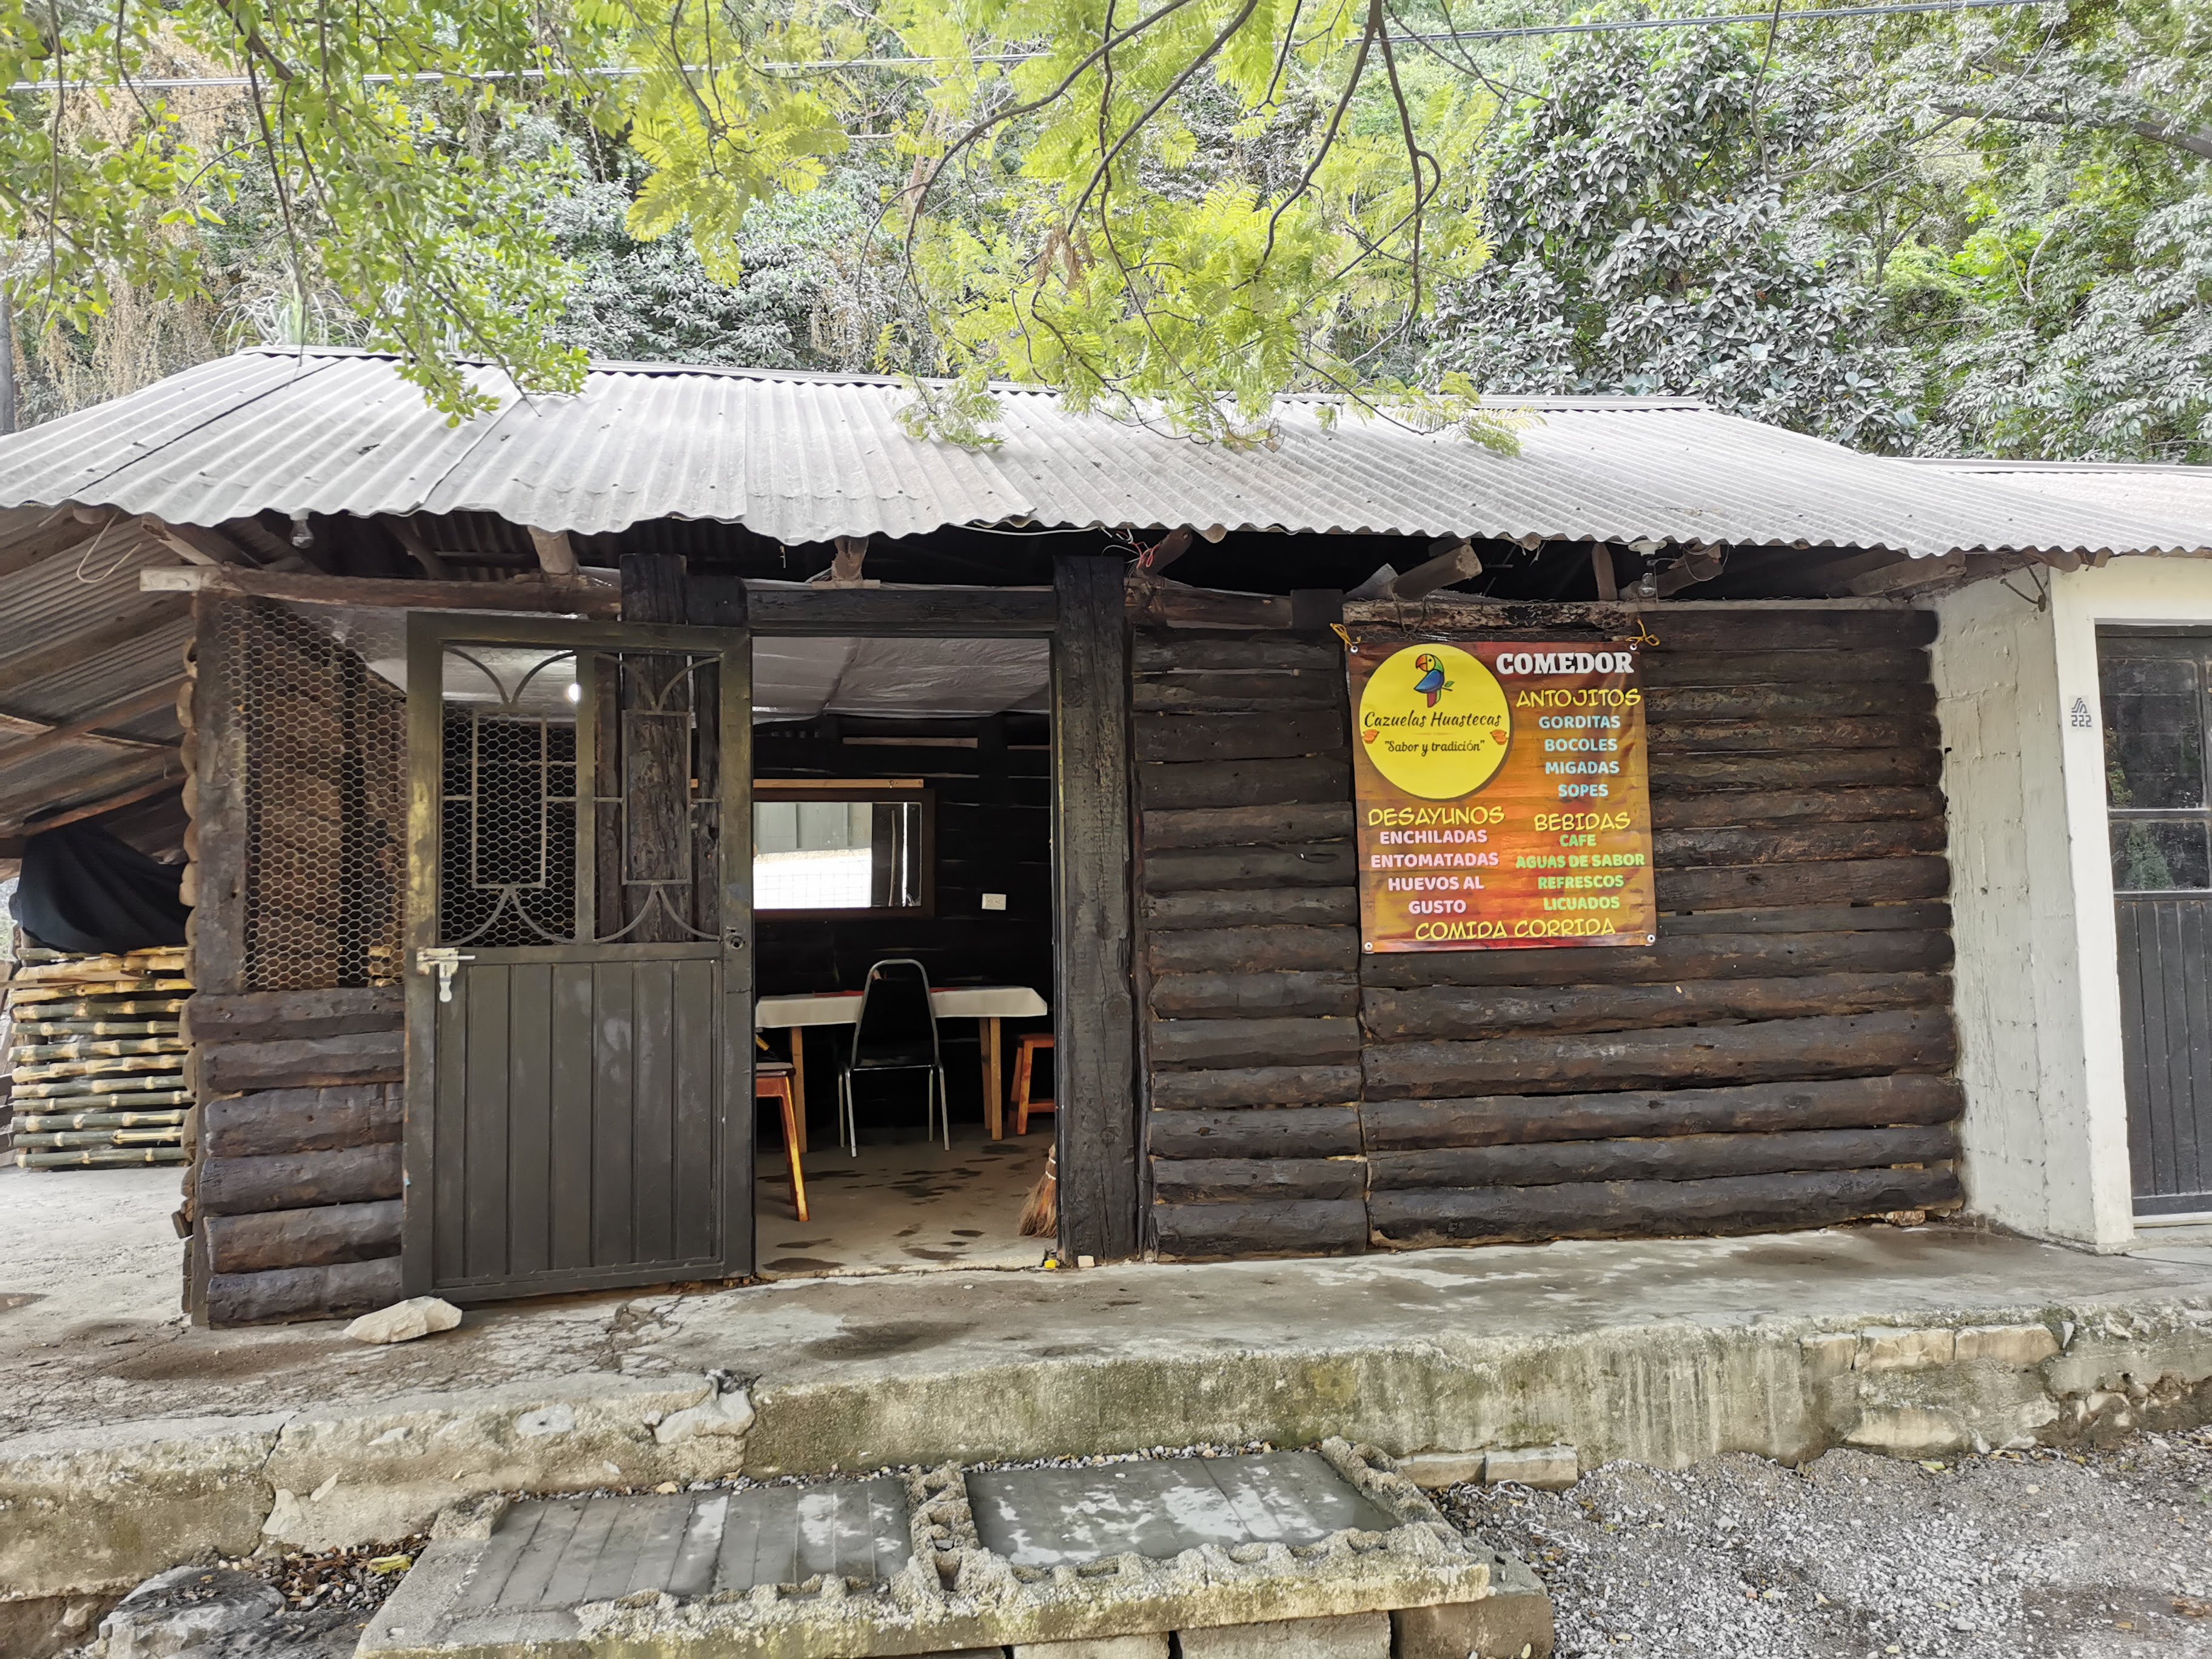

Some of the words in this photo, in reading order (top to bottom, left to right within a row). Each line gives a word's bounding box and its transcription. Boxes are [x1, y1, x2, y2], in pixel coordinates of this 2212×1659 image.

[1496, 652, 1634, 674] COMEDOR
[1516, 688, 1641, 707] ANTOJITOS
[1364, 711, 1426, 728] Cazuelas
[1430, 711, 1501, 726] Huastecas
[1539, 716, 1620, 729] GORDITAS
[2071, 714, 2092, 728] 222
[1421, 745, 1428, 756] y
[1544, 739, 1618, 752] BOCOLES
[1545, 762, 1620, 774] MIGADAS
[1558, 784, 1609, 797] SOPES
[1368, 806, 1505, 826] DESAYUNOS
[1534, 812, 1631, 831] BEBIDAS
[1380, 830, 1487, 845] ENCHILADAS
[1560, 834, 1596, 847] CAFE
[1371, 853, 1498, 868] ENTOMATADAS
[1516, 856, 1566, 868] AGUAS
[1569, 856, 1587, 867] DE
[1592, 854, 1645, 867] SABOR
[1388, 877, 1460, 891] HUEVOS
[1464, 876, 1484, 890] AL
[1538, 876, 1624, 888] REFRESCOS
[1409, 900, 1466, 914] GUSTO
[1544, 897, 1620, 910] LICUADOS
[1415, 920, 1507, 940] COMIDA
[1514, 918, 1615, 937] CORRIDA
